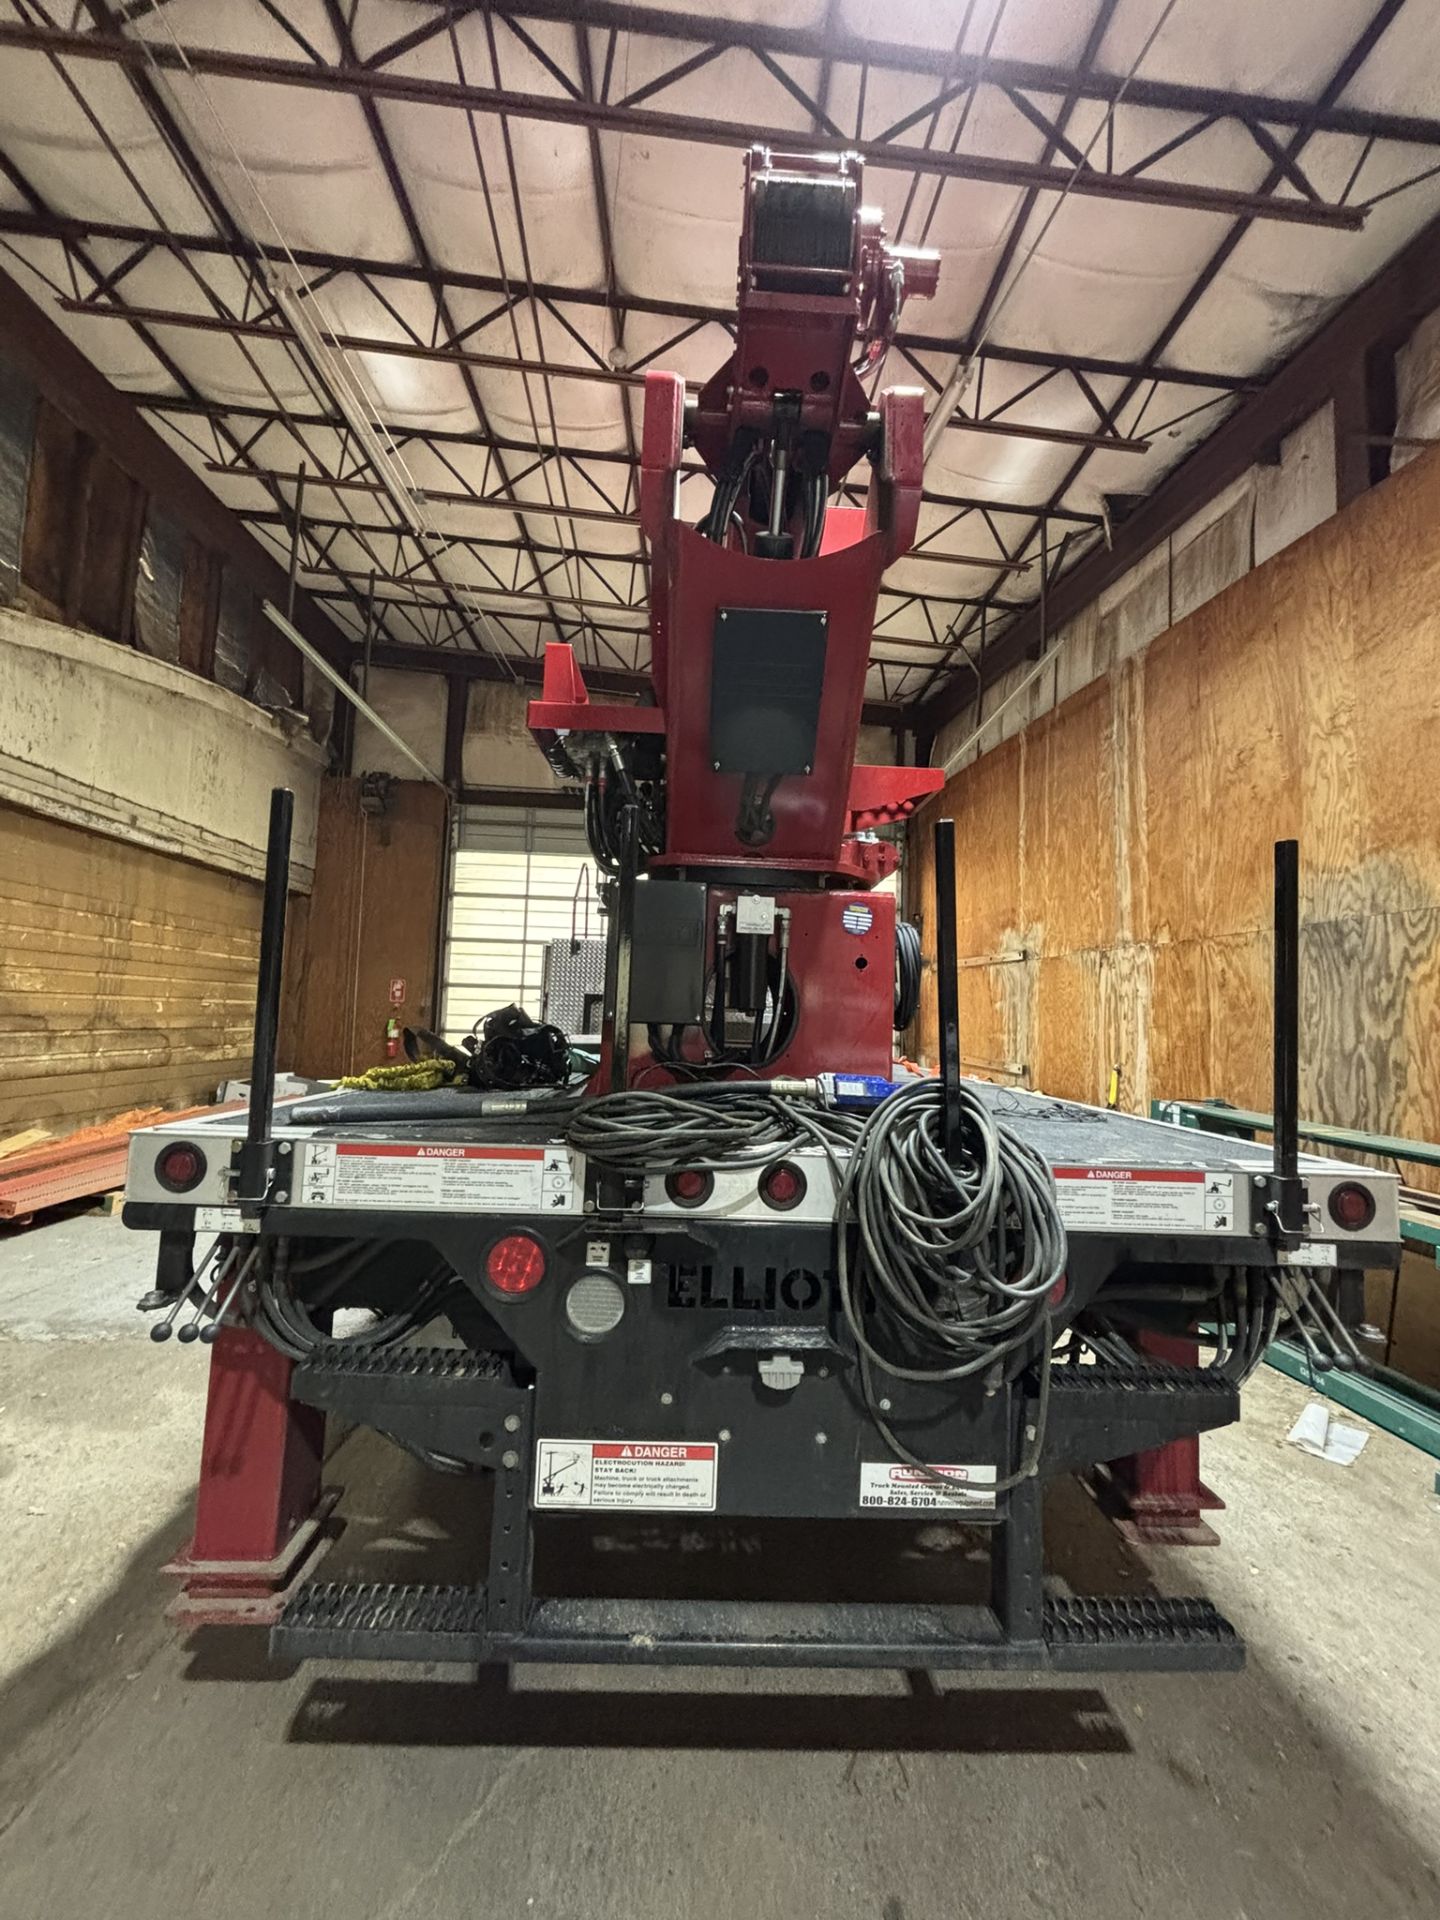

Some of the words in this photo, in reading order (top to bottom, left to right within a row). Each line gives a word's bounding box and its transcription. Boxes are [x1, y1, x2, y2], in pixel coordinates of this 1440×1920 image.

[426, 1148, 466, 1157] DANGER
[1096, 1171, 1132, 1179] DANGER
[634, 1446, 687, 1458] DANGER
[862, 1495, 937, 1506] 800-824-6704
